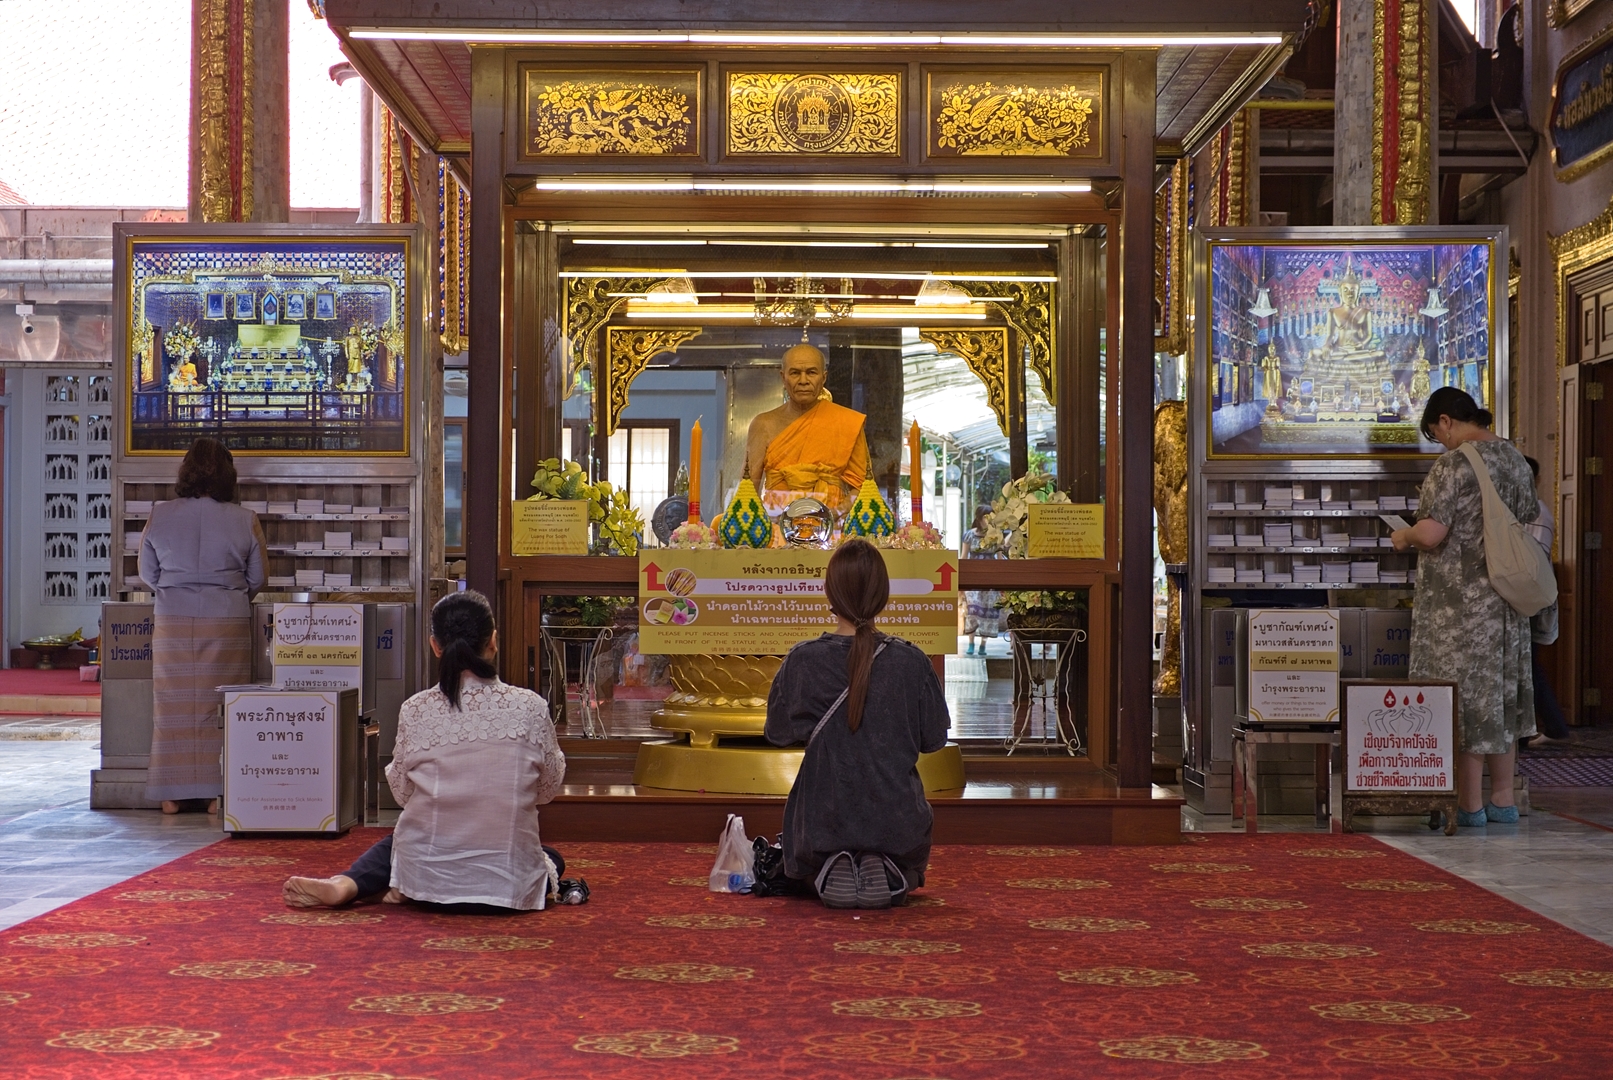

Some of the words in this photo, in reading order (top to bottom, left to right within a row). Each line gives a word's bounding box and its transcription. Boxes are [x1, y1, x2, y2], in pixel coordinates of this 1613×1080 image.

[725, 581, 826, 594] โปรดวางธูปเทียน
[1259, 620, 1329, 634] บูชากัณฑ์เทศน์
[1255, 637, 1333, 647] มหาเวสสันดรชาดก
[320, 651, 358, 659] นครกัณฑ์
[1258, 655, 1287, 665] กัณฑ์ที่
[1373, 648, 1410, 666] ภัตตา
[1261, 683, 1326, 695] บำรุงพระอาราม
[236, 706, 327, 726] พระภิกษุสงฆ์
[257, 731, 304, 741] อาพาธ
[1364, 732, 1438, 751] เชิญบริจาคปัจจัย
[1358, 751, 1443, 768] เพื่อการบริจาคโลหิต
[240, 764, 320, 778] บำรุงพระอาราม
[1356, 770, 1447, 787] ช่วยชีวิตเพื่อนร่วมชาติ
